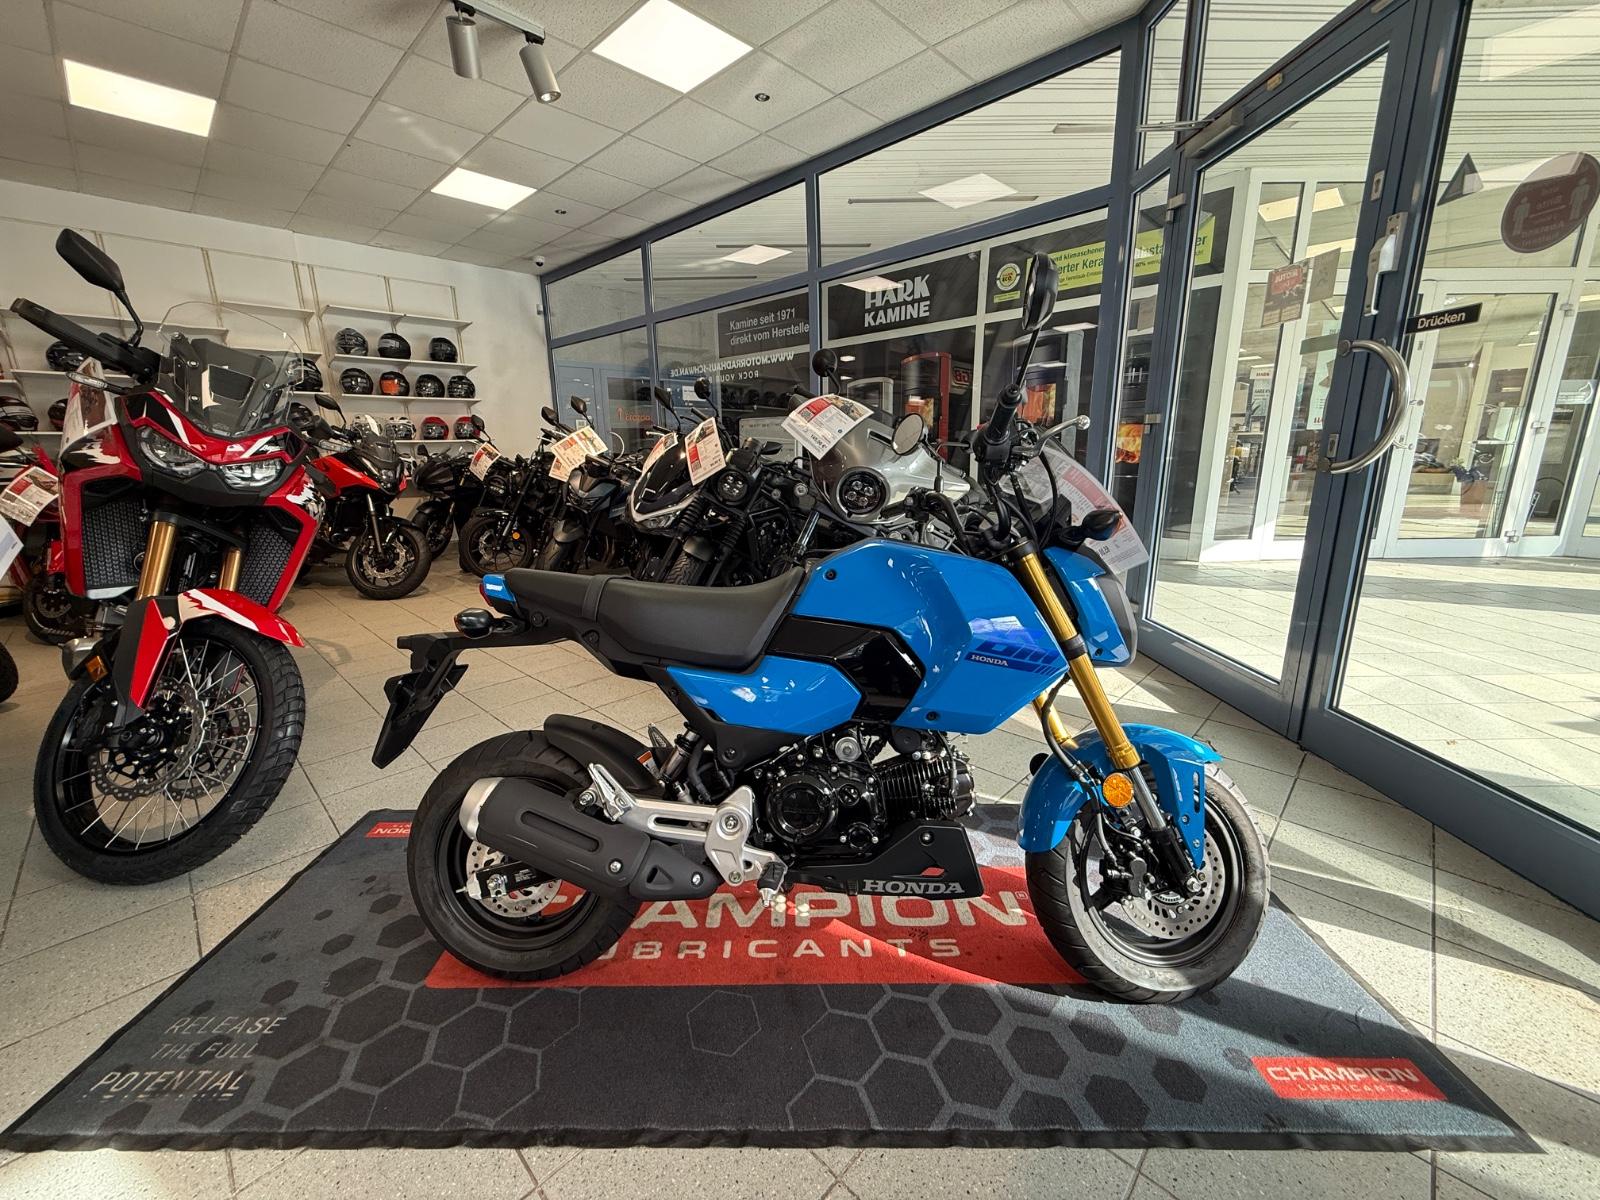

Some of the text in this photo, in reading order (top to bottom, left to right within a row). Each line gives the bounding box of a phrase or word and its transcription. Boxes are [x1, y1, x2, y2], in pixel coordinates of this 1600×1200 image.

[1082, 257, 1103, 270] Kera
[864, 274, 930, 309] HARK
[729, 307, 796, 331] Kamine seit 1971
[864, 300, 930, 327] KAMINE
[1417, 312, 1466, 329] Drücken
[730, 321, 810, 345] direkt vom Herstelle
[971, 654, 1009, 666] HONDA
[862, 879, 965, 894] HONDA
[630, 891, 1027, 928] AMPION
[597, 938, 961, 960] UBRICANTS
[164, 1016, 287, 1035] RELEASE
[151, 1042, 258, 1060] THE FULL
[89, 1069, 248, 1092] POTENTIAL
[1266, 1066, 1420, 1083] CHAMPION
[1298, 1083, 1409, 1093] LUBRICANTS
